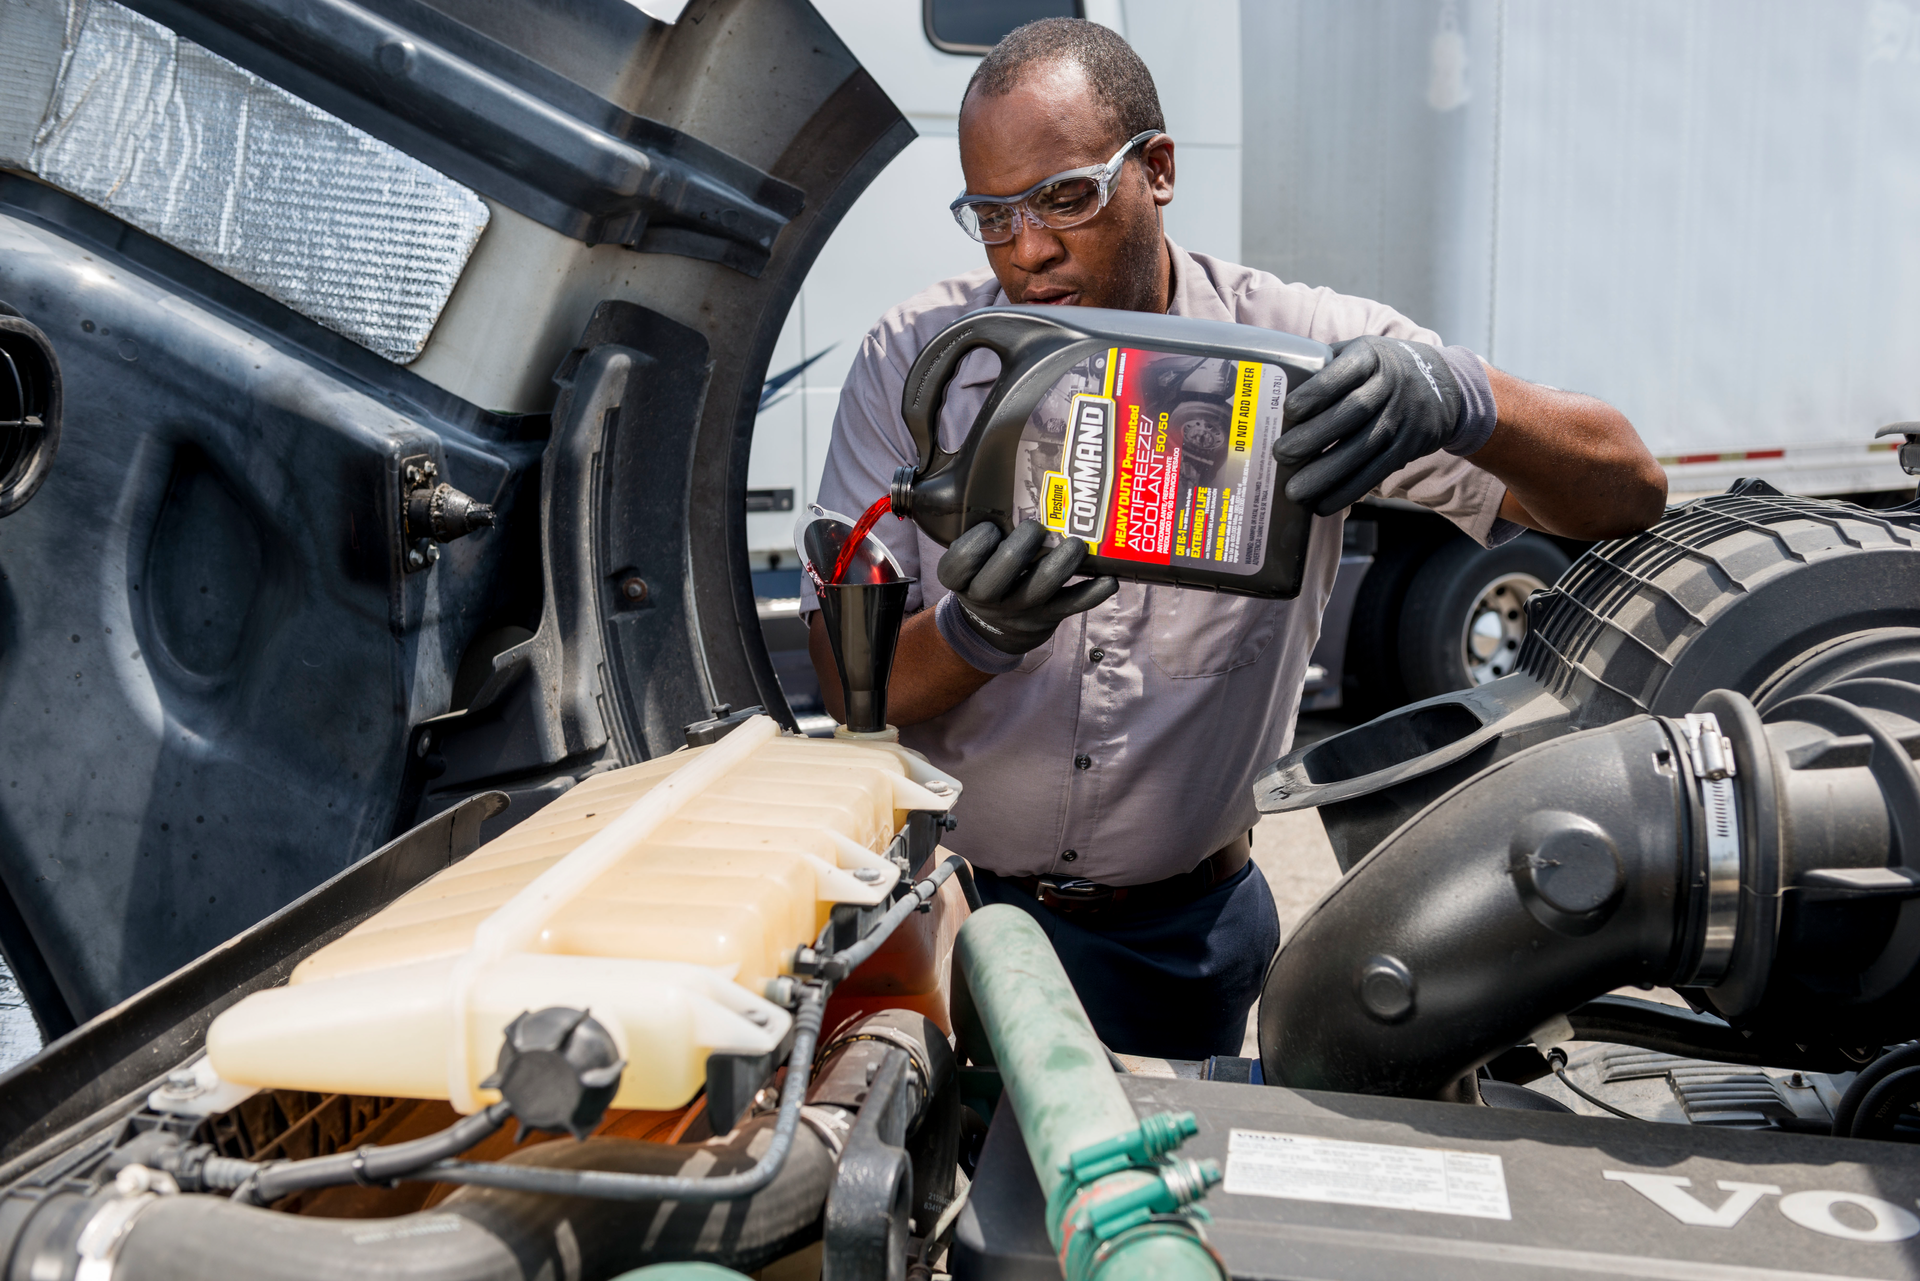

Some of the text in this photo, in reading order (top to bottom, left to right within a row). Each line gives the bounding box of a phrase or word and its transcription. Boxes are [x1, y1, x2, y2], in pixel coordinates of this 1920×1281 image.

[1235, 367, 1254, 452] DO NOT ADD WATER
[1271, 395, 1280, 406] GAL
[1272, 381, 1282, 395] (3.78
[1050, 484, 1065, 519] Prestone
[1073, 406, 1103, 531] COMMAND
[1115, 404, 1140, 547] HEAVY DUTY Prediluted
[1127, 414, 1154, 551] ANTIFREEZE/
[1142, 412, 1169, 552] COOLANT 50/50
[1163, 447, 1180, 554] PREDILUIDO 50/50 SERVICIO PESADO
[1175, 544, 1185, 556] CAT
[1176, 530, 1187, 544] EC-1
[1190, 486, 1208, 558] EXTENDED LIFE
[1215, 487, 1231, 561] 600,000 Mile Service Life
[1245, 541, 1254, 565] WARNING:
[1252, 537, 1262, 566] ADVERTENCIA:
[1602, 1170, 1920, 1242] VO
